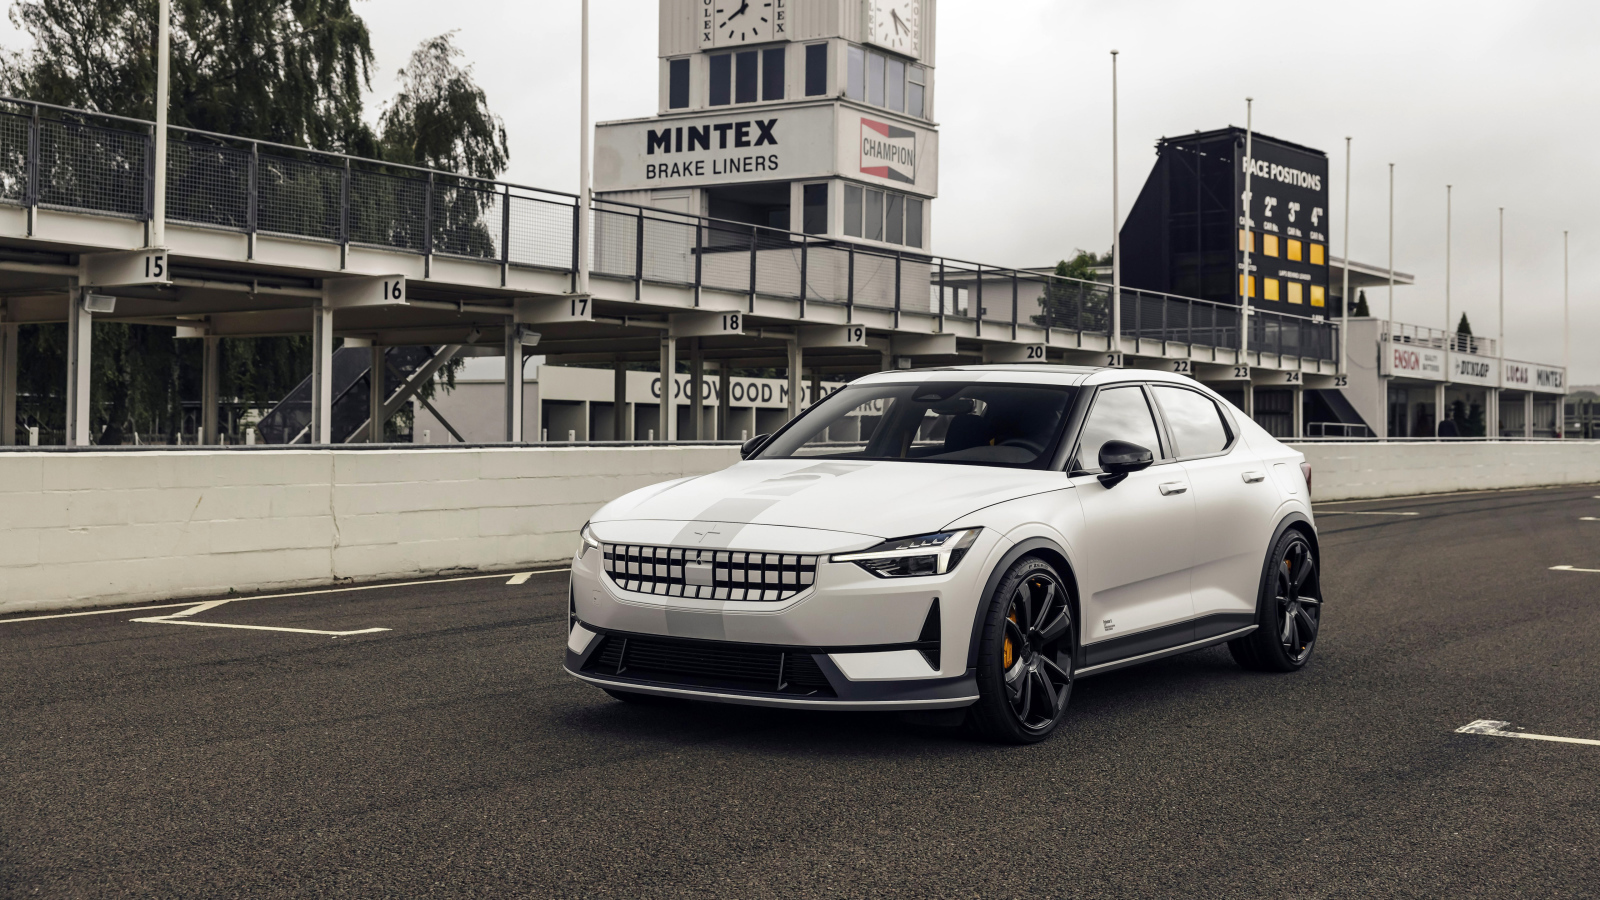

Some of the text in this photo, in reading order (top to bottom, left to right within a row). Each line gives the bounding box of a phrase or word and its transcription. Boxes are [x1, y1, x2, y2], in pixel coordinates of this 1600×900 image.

[647, 119, 778, 154] MINTEX
[863, 137, 914, 167] CHAMPION
[646, 154, 779, 179] BRAKE LINERS
[1270, 163, 1321, 191] POSITIONS
[145, 256, 163, 278] 15
[384, 281, 402, 300] 16
[571, 299, 588, 316] 17
[723, 314, 739, 330] 18
[848, 328, 863, 343] 19
[1027, 346, 1043, 359] 20
[1107, 354, 1121, 366] 21
[1394, 349, 1420, 370] ENSIGN
[1174, 361, 1188, 372] 22
[1234, 367, 1248, 378] 23
[1460, 360, 1490, 377] DUNLOP
[1506, 364, 1528, 384] LUCAS
[1286, 372, 1299, 382] 24
[1334, 376, 1348, 387] 25
[1536, 369, 1564, 388] MINTEX
